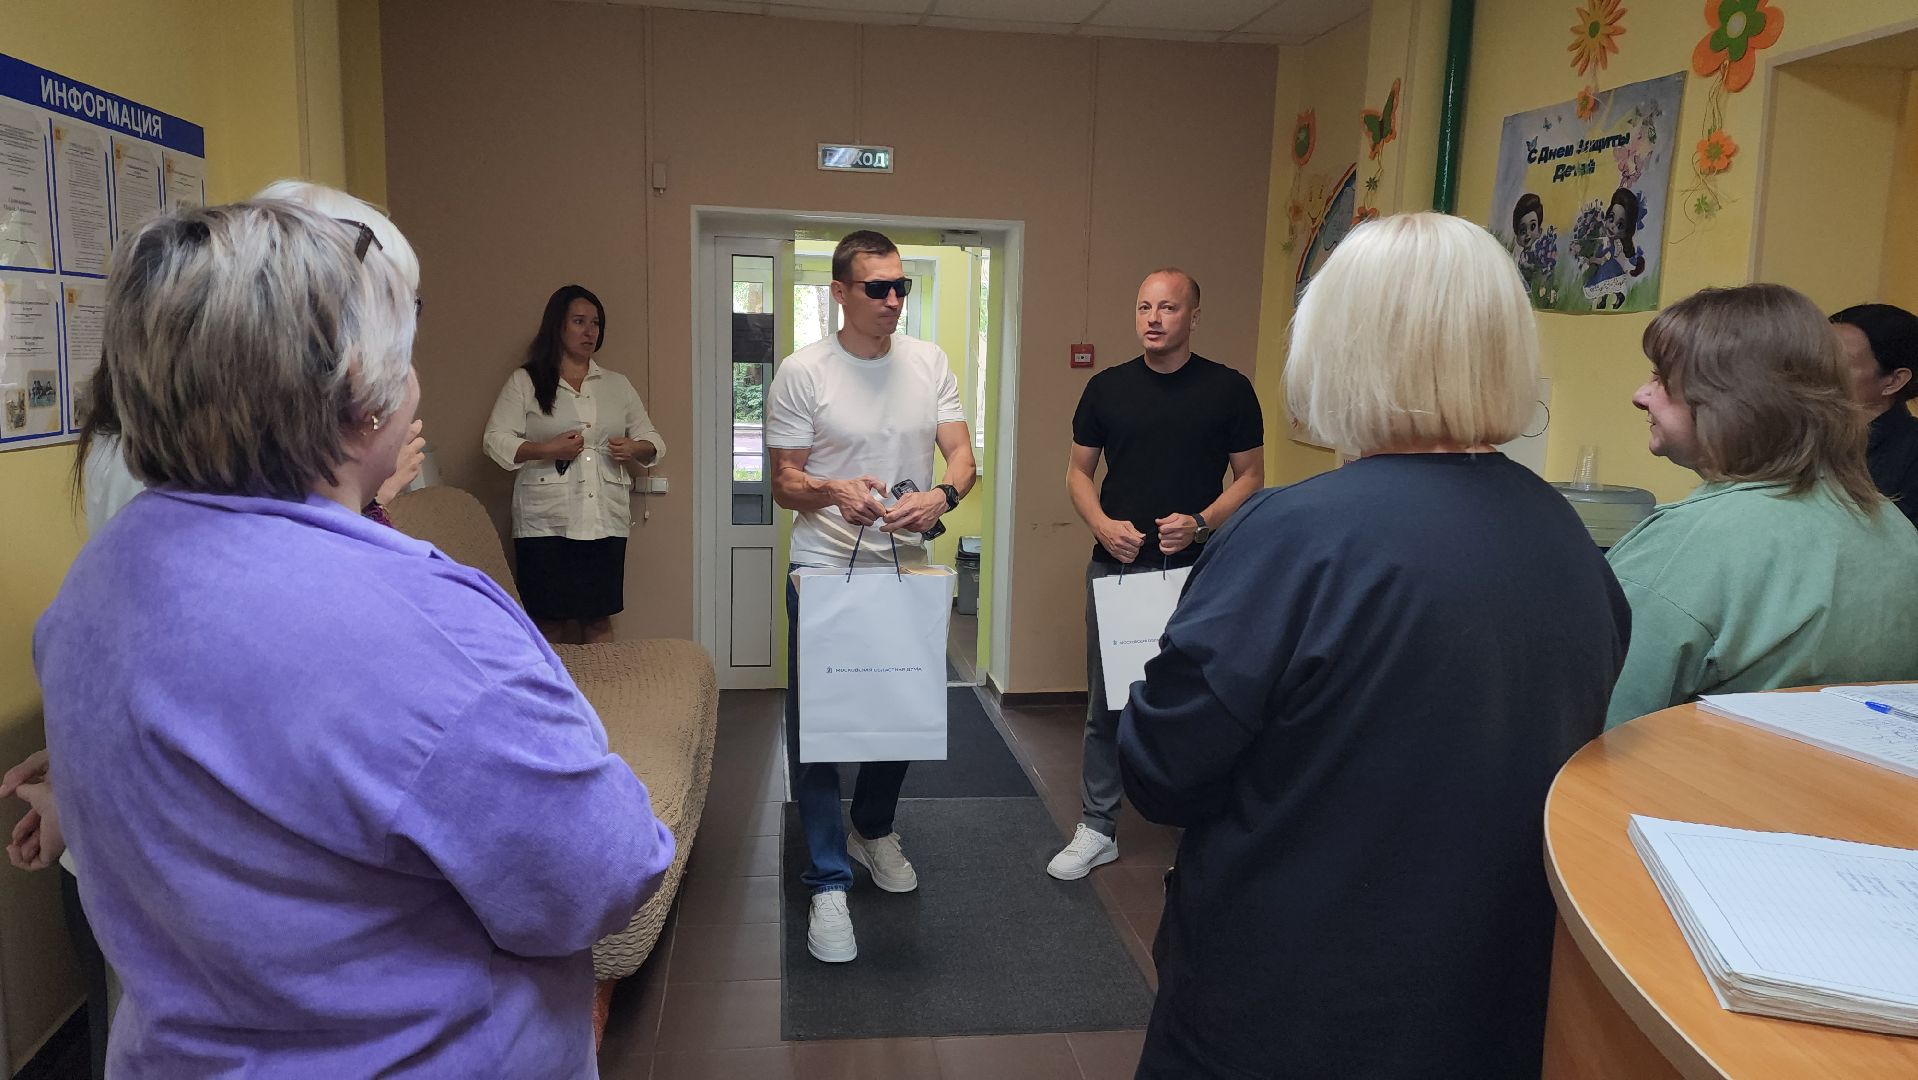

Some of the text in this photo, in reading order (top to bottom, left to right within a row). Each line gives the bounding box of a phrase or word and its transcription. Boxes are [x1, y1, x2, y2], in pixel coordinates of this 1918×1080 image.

[41, 75, 163, 140] ИНФОРМАЦИЯ
[824, 149, 887, 168] ВХОД
[1527, 148, 1538, 164] С
[1537, 144, 1574, 165] Днем
